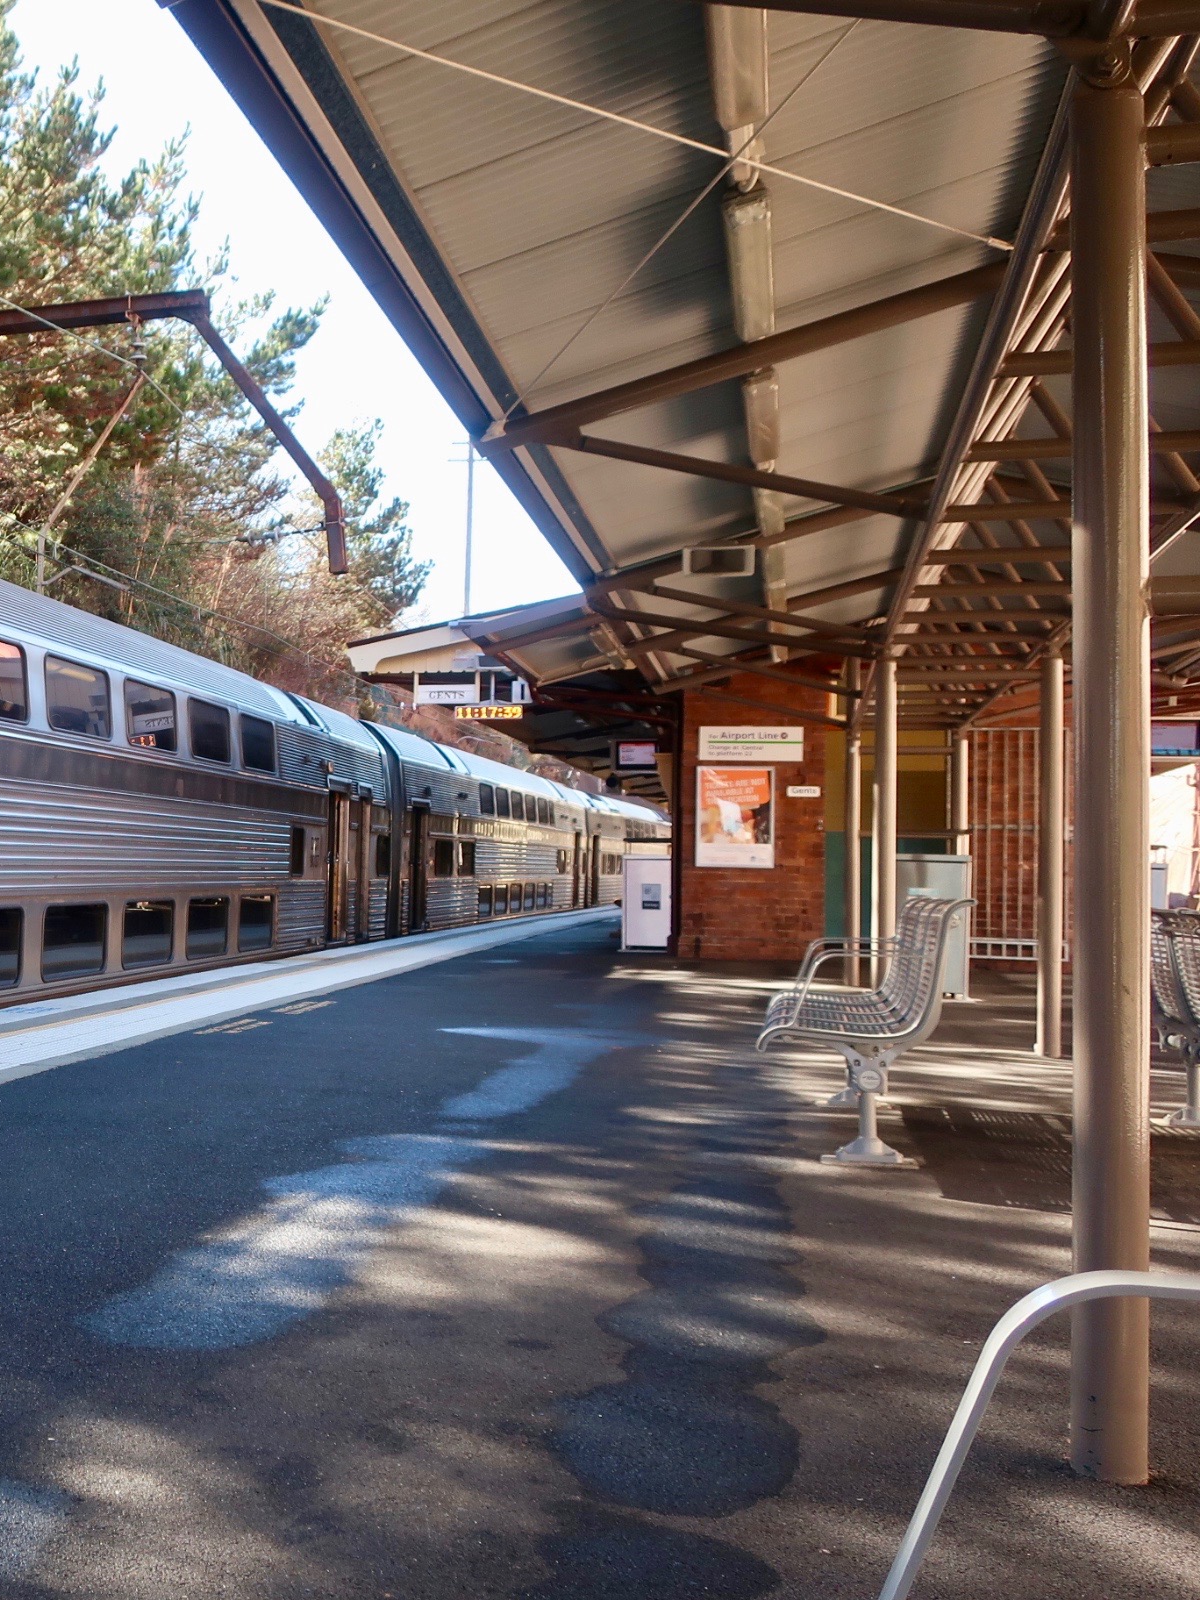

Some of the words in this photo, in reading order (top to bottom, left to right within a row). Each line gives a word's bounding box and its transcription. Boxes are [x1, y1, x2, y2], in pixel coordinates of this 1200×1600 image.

[428, 690, 466, 700] GENTS
[456, 706, 522, 719] 11:17:39
[720, 731, 755, 741] Airport
[758, 731, 779, 740] Line
[791, 787, 818, 795] Gents
